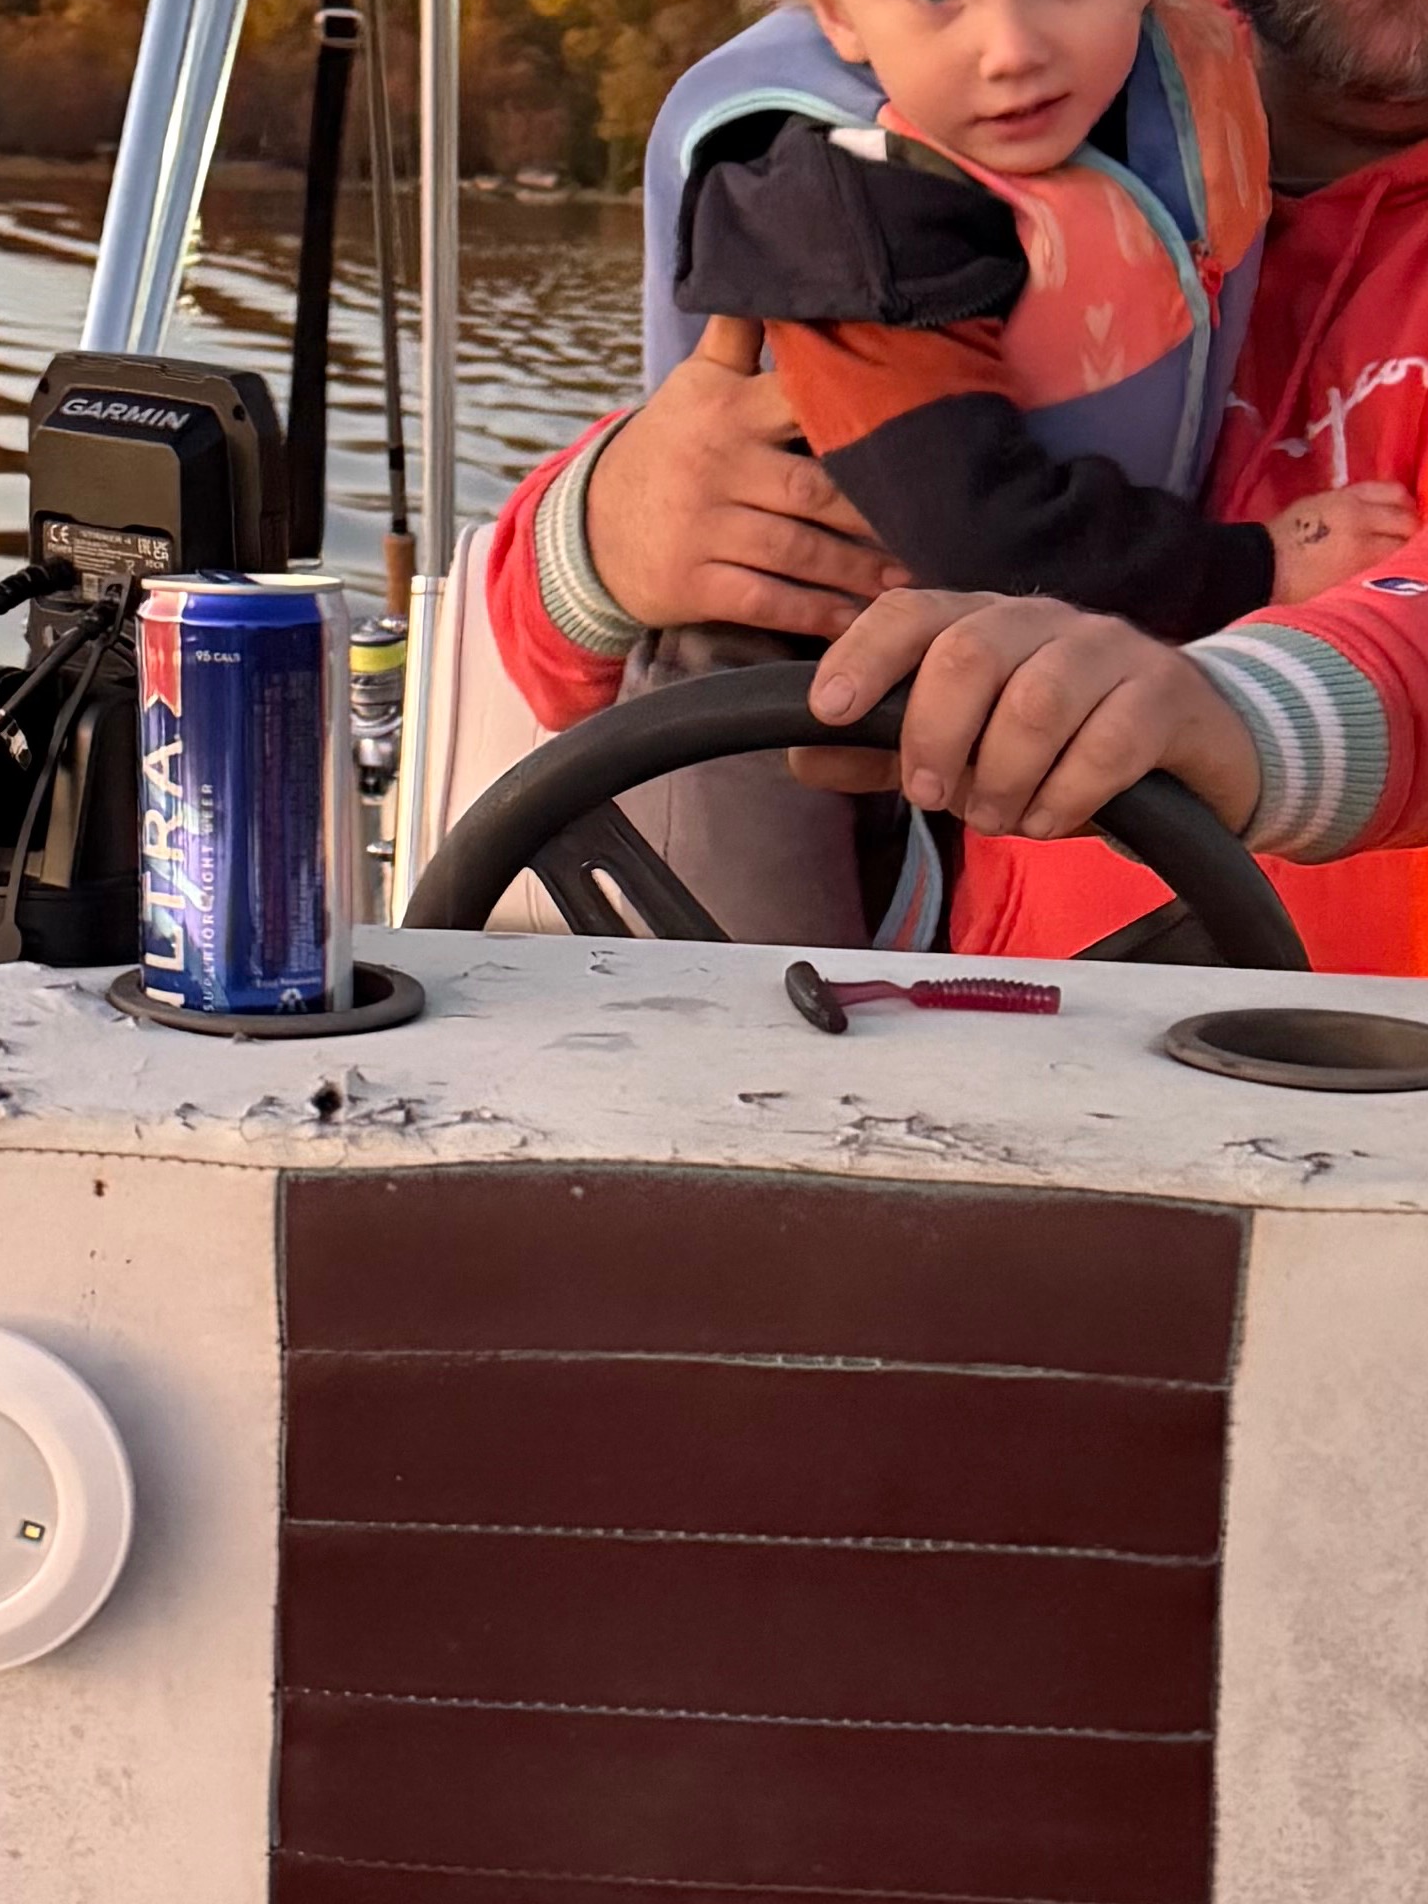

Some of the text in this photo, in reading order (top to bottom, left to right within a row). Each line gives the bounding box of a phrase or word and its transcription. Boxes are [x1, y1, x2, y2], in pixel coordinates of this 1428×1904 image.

[60, 398, 190, 430] GARMIN
[195, 649, 212, 663] 95
[201, 782, 215, 837] BEER
